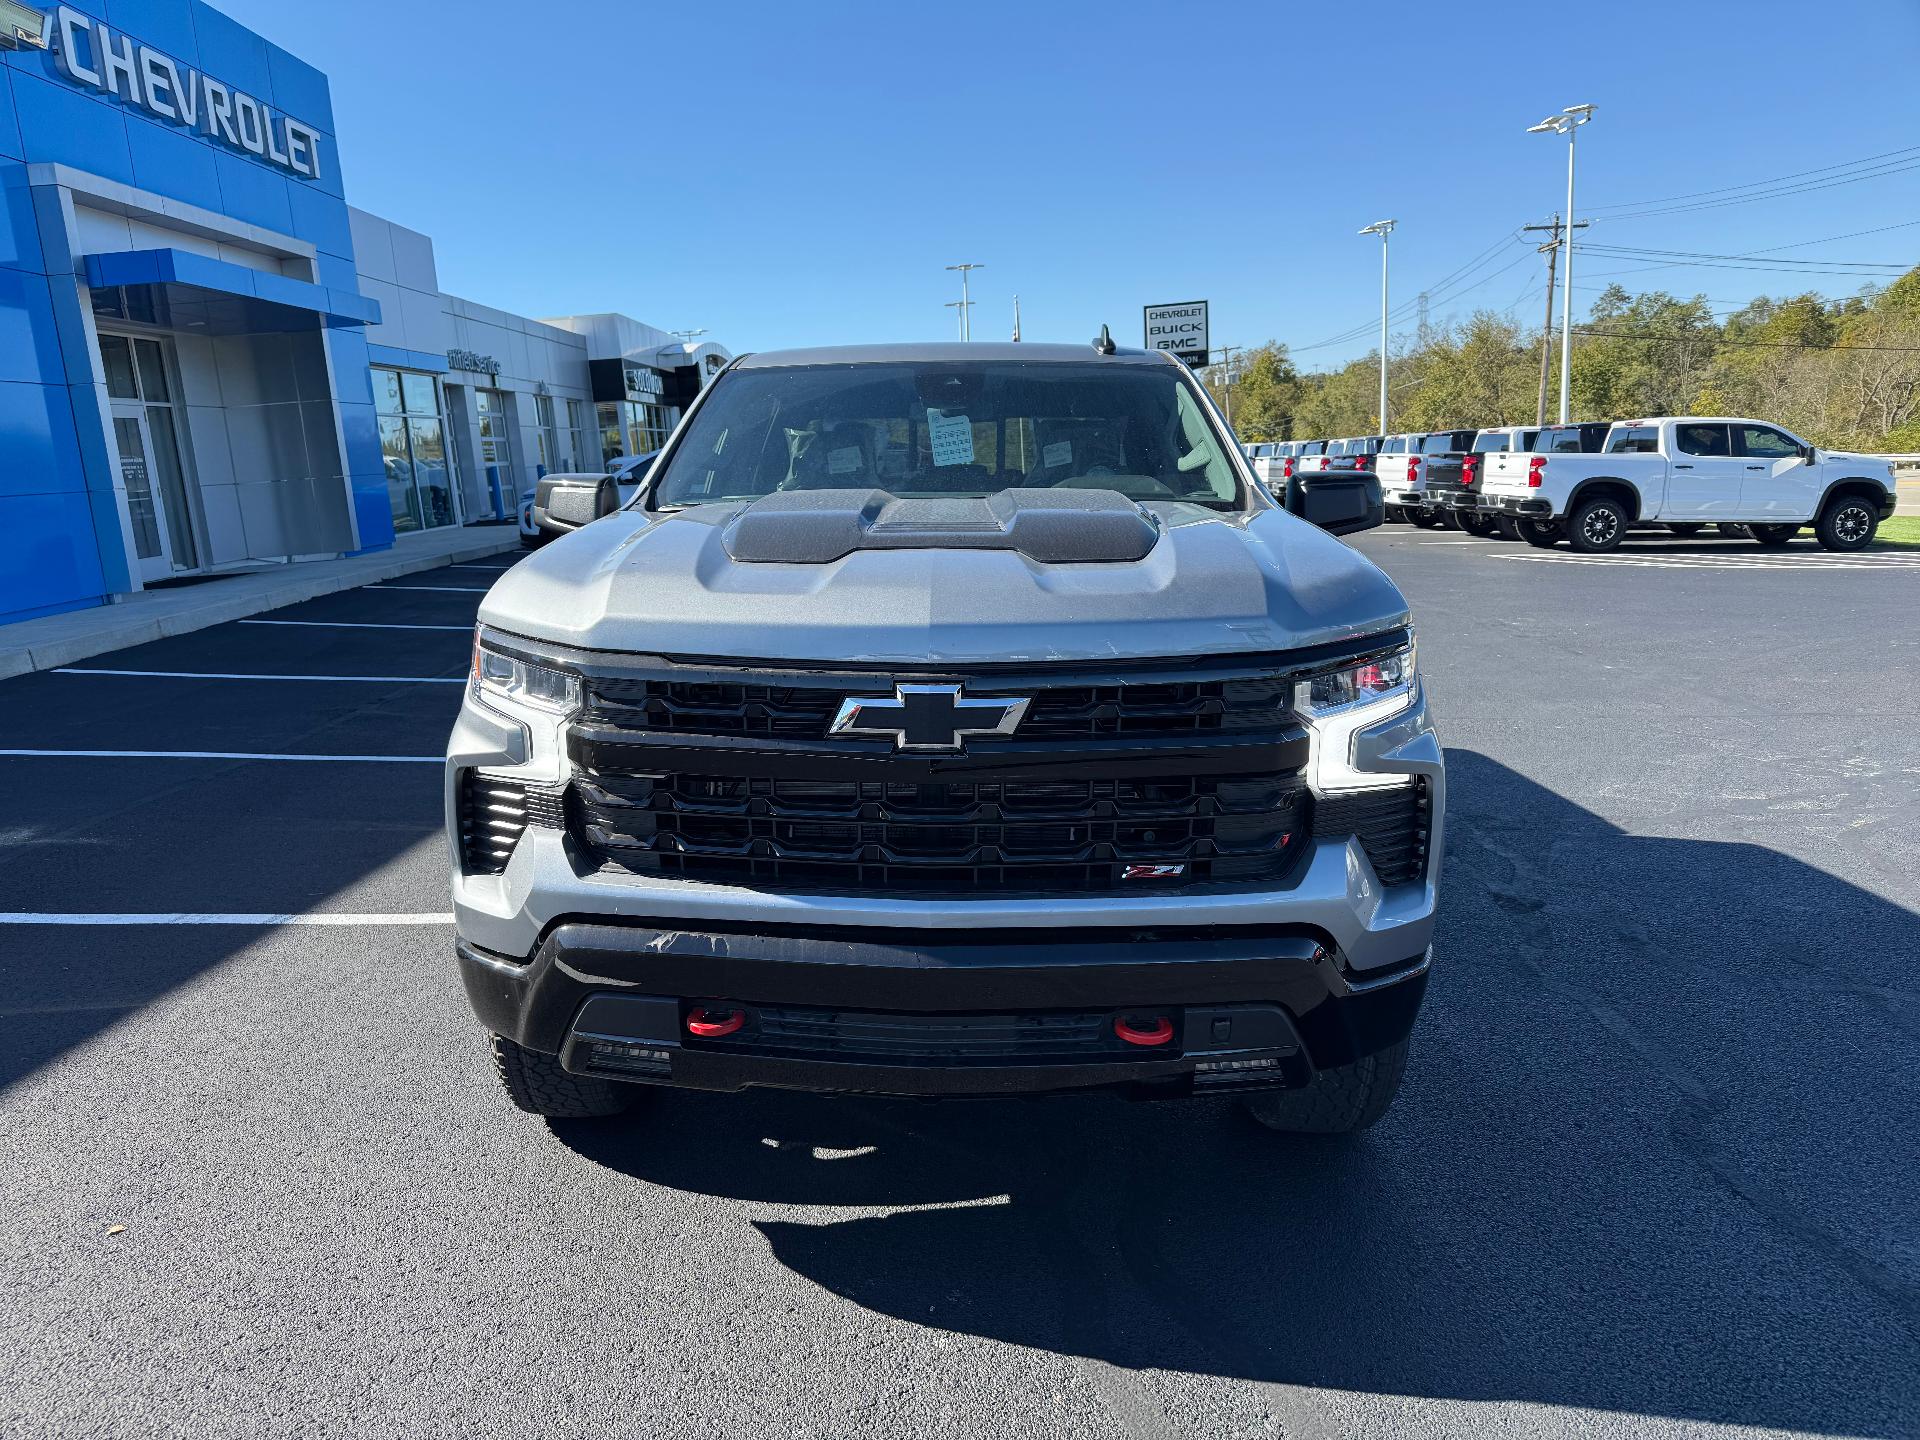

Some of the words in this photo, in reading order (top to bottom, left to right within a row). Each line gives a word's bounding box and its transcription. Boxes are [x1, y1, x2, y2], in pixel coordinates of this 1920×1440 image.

[56, 5, 321, 180] CHEVROLET
[1149, 308, 1203, 320] CHEVROLET
[1150, 322, 1203, 335] BUICK
[1157, 337, 1198, 350] GMC
[633, 368, 664, 395] SOLOMON
